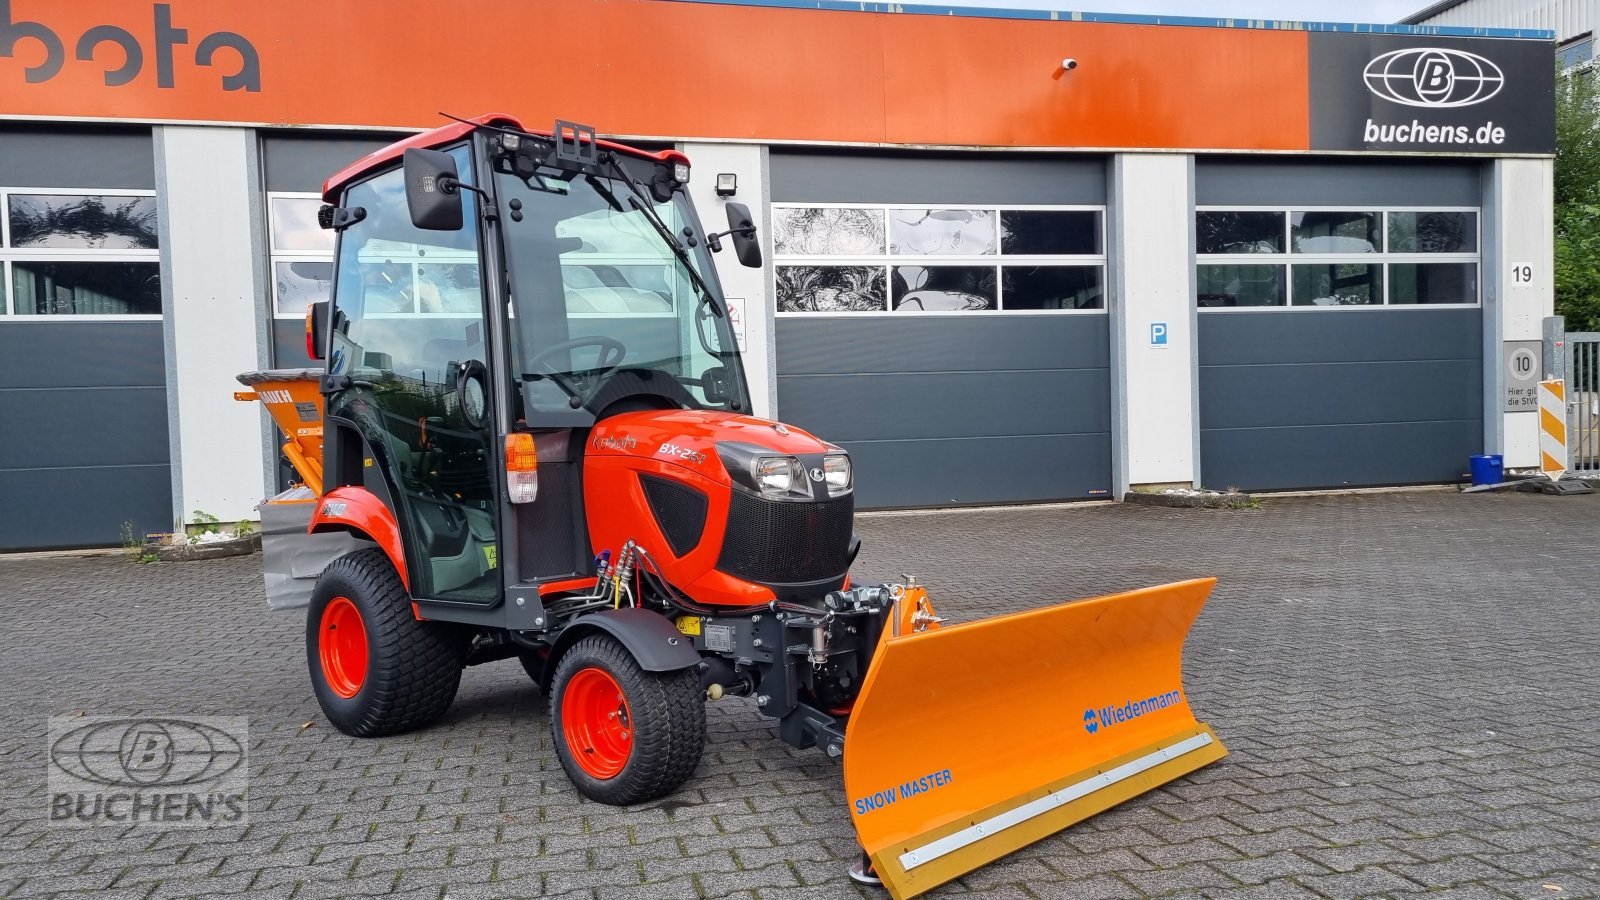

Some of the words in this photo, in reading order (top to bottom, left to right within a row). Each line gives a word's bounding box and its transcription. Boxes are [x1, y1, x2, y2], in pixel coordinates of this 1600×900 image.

[1363, 119, 1506, 145] buchens.de
[1512, 266, 1532, 283] 19
[1152, 325, 1165, 343] P
[1515, 356, 1530, 372] 10
[1508, 388, 1524, 396] Hier
[1527, 387, 1538, 397] gil
[1508, 398, 1520, 406] die
[1098, 690, 1182, 729] Wiedenmann
[855, 788, 897, 815] SNOW
[900, 768, 953, 799] MASTER
